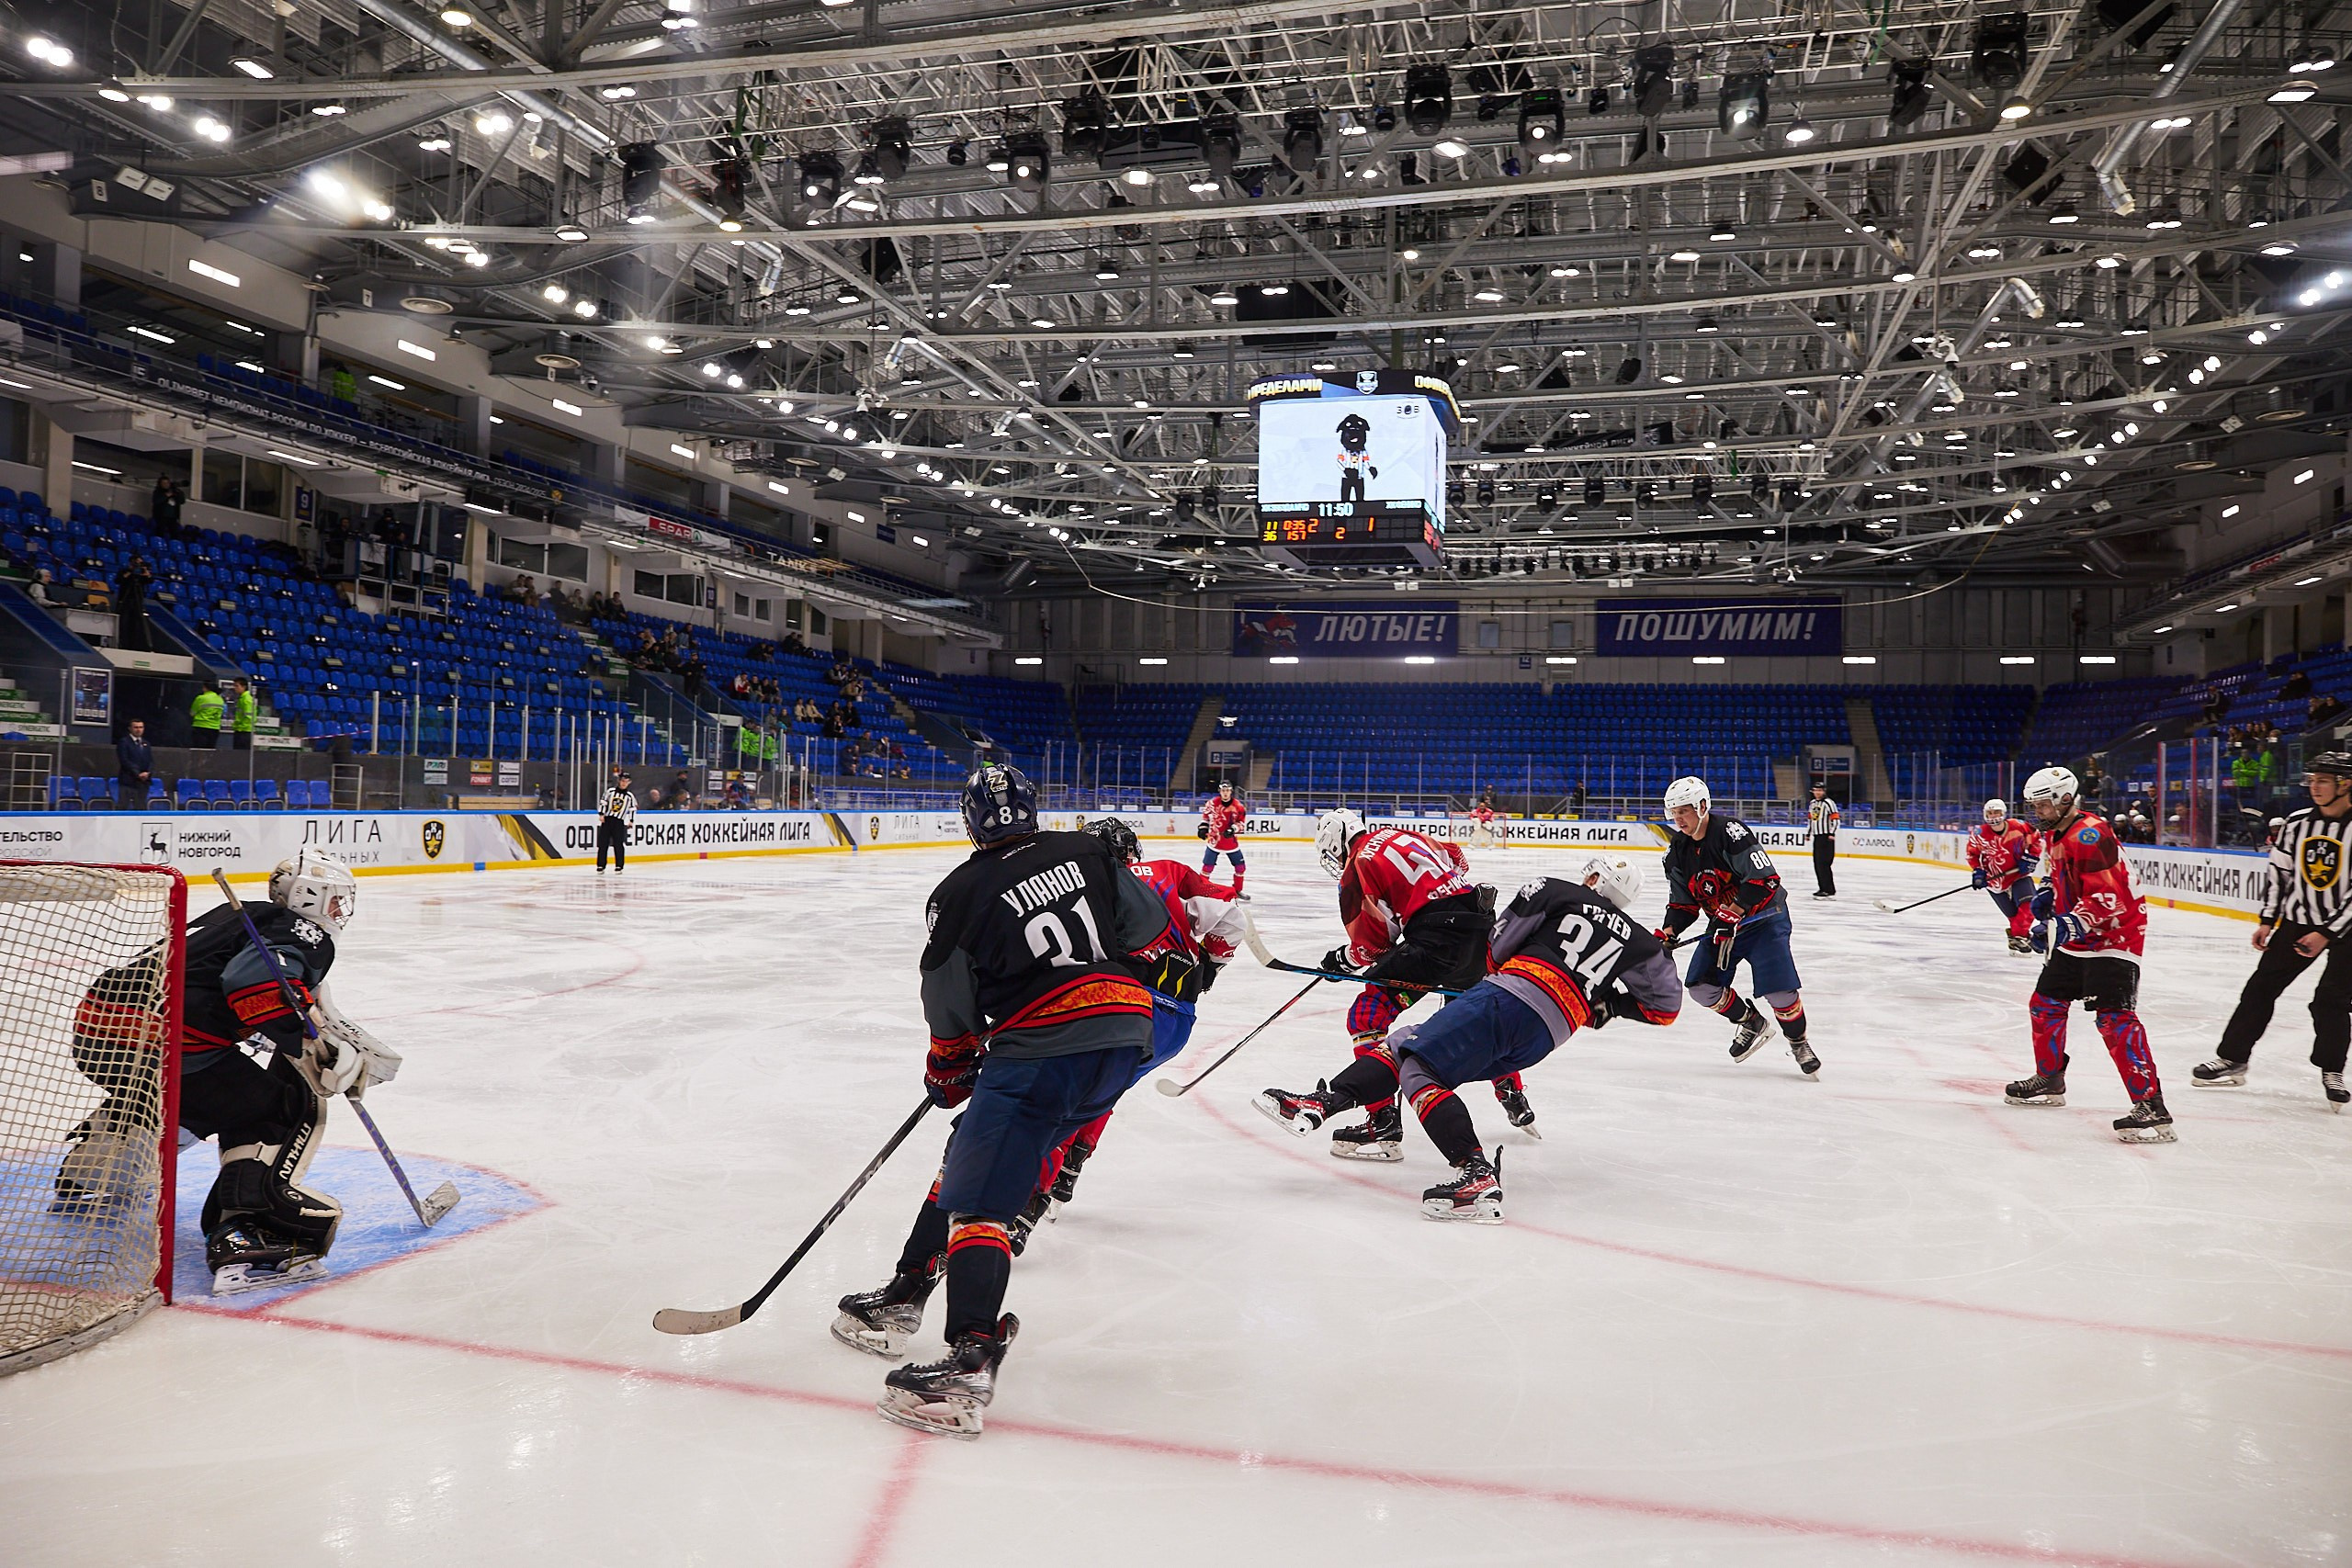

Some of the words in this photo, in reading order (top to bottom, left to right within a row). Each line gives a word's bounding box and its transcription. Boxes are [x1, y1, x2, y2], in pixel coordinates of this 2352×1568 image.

[659, 522, 691, 538] SPAR
[1315, 615, 1447, 642] ЛЮТЫЕ!
[1615, 613, 1816, 641] ПОШУМИМ!
[999, 806, 1013, 825] 8
[179, 829, 231, 842] НИЖНИЙ
[302, 819, 382, 844] ЛИГА
[566, 823, 685, 850] ОФЕРСКАЯ
[692, 817, 775, 844] ХОККЕЙНАЯ
[780, 822, 809, 840] ЛИГА
[1587, 829, 1627, 840] ЛИГА
[178, 846, 241, 859] НОВГОРОД
[1001, 861, 1087, 918] УЛАНОВ
[2163, 858, 2240, 897] ХОККЕЙНАЯ
[1023, 895, 1108, 967] 21
[1169, 953, 1193, 966] BAUER
[1556, 913, 1625, 1001] 34
[865, 1303, 915, 1317] VAPOR
